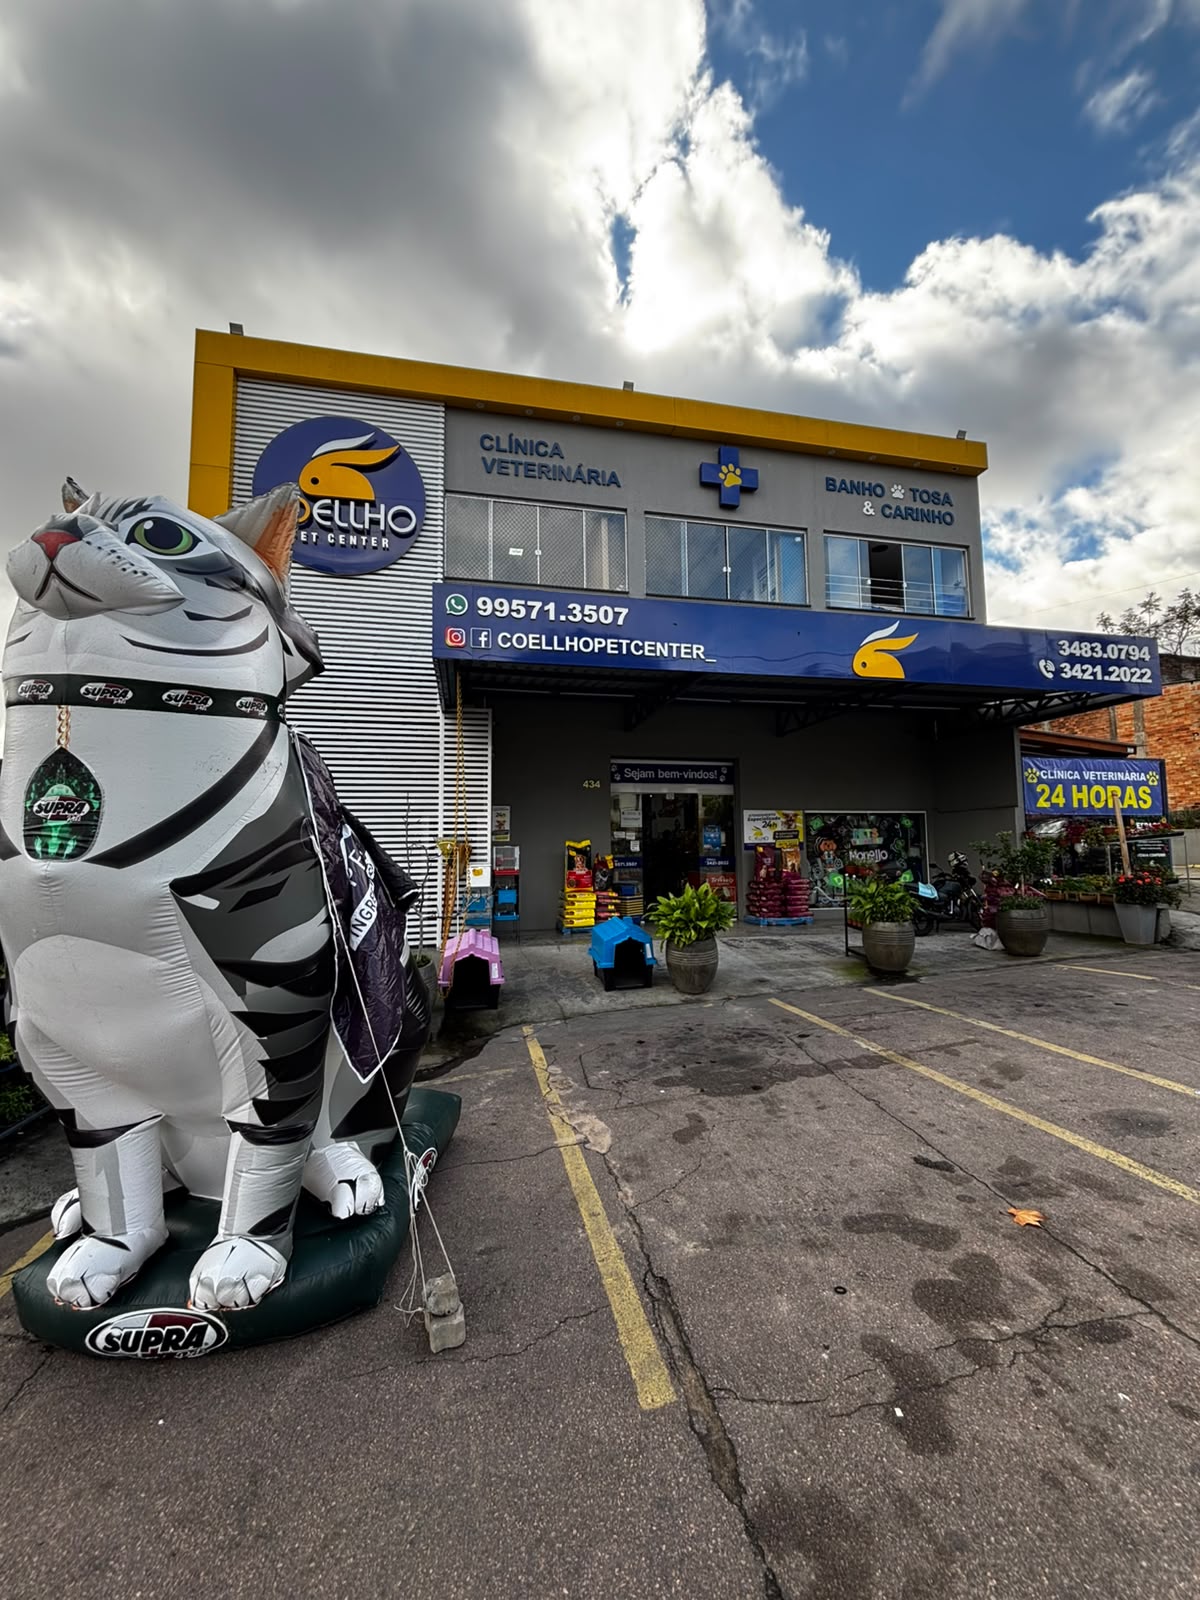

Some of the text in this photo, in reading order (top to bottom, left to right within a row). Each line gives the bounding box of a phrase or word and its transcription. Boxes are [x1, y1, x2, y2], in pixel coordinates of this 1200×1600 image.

[479, 432, 565, 459] CLÍNICA
[481, 456, 621, 488] VETERINÁRIA
[825, 476, 954, 507] BANHO TOSA
[862, 500, 955, 526] & CARINHO
[300, 531, 390, 549] ET CENTER
[476, 596, 630, 626] 99571.3507
[497, 632, 717, 662] COELLHOPETCENTER_
[1058, 640, 1151, 662] 3483.0794
[1060, 662, 1153, 683] 3421.2022
[20, 683, 51, 695] SUPRA
[82, 687, 130, 699] SUPRA
[164, 692, 211, 706] SUPRA
[237, 699, 267, 711] SUPRA
[623, 767, 718, 780] Sejam bem-vindos!
[1040, 767, 1147, 782] CLÍNICA VETERINÁRIA
[582, 780, 601, 789] 434
[1035, 783, 1153, 809] 24 HORAS
[35, 801, 87, 815] SUPRA
[102, 1322, 210, 1354] SUPRA
